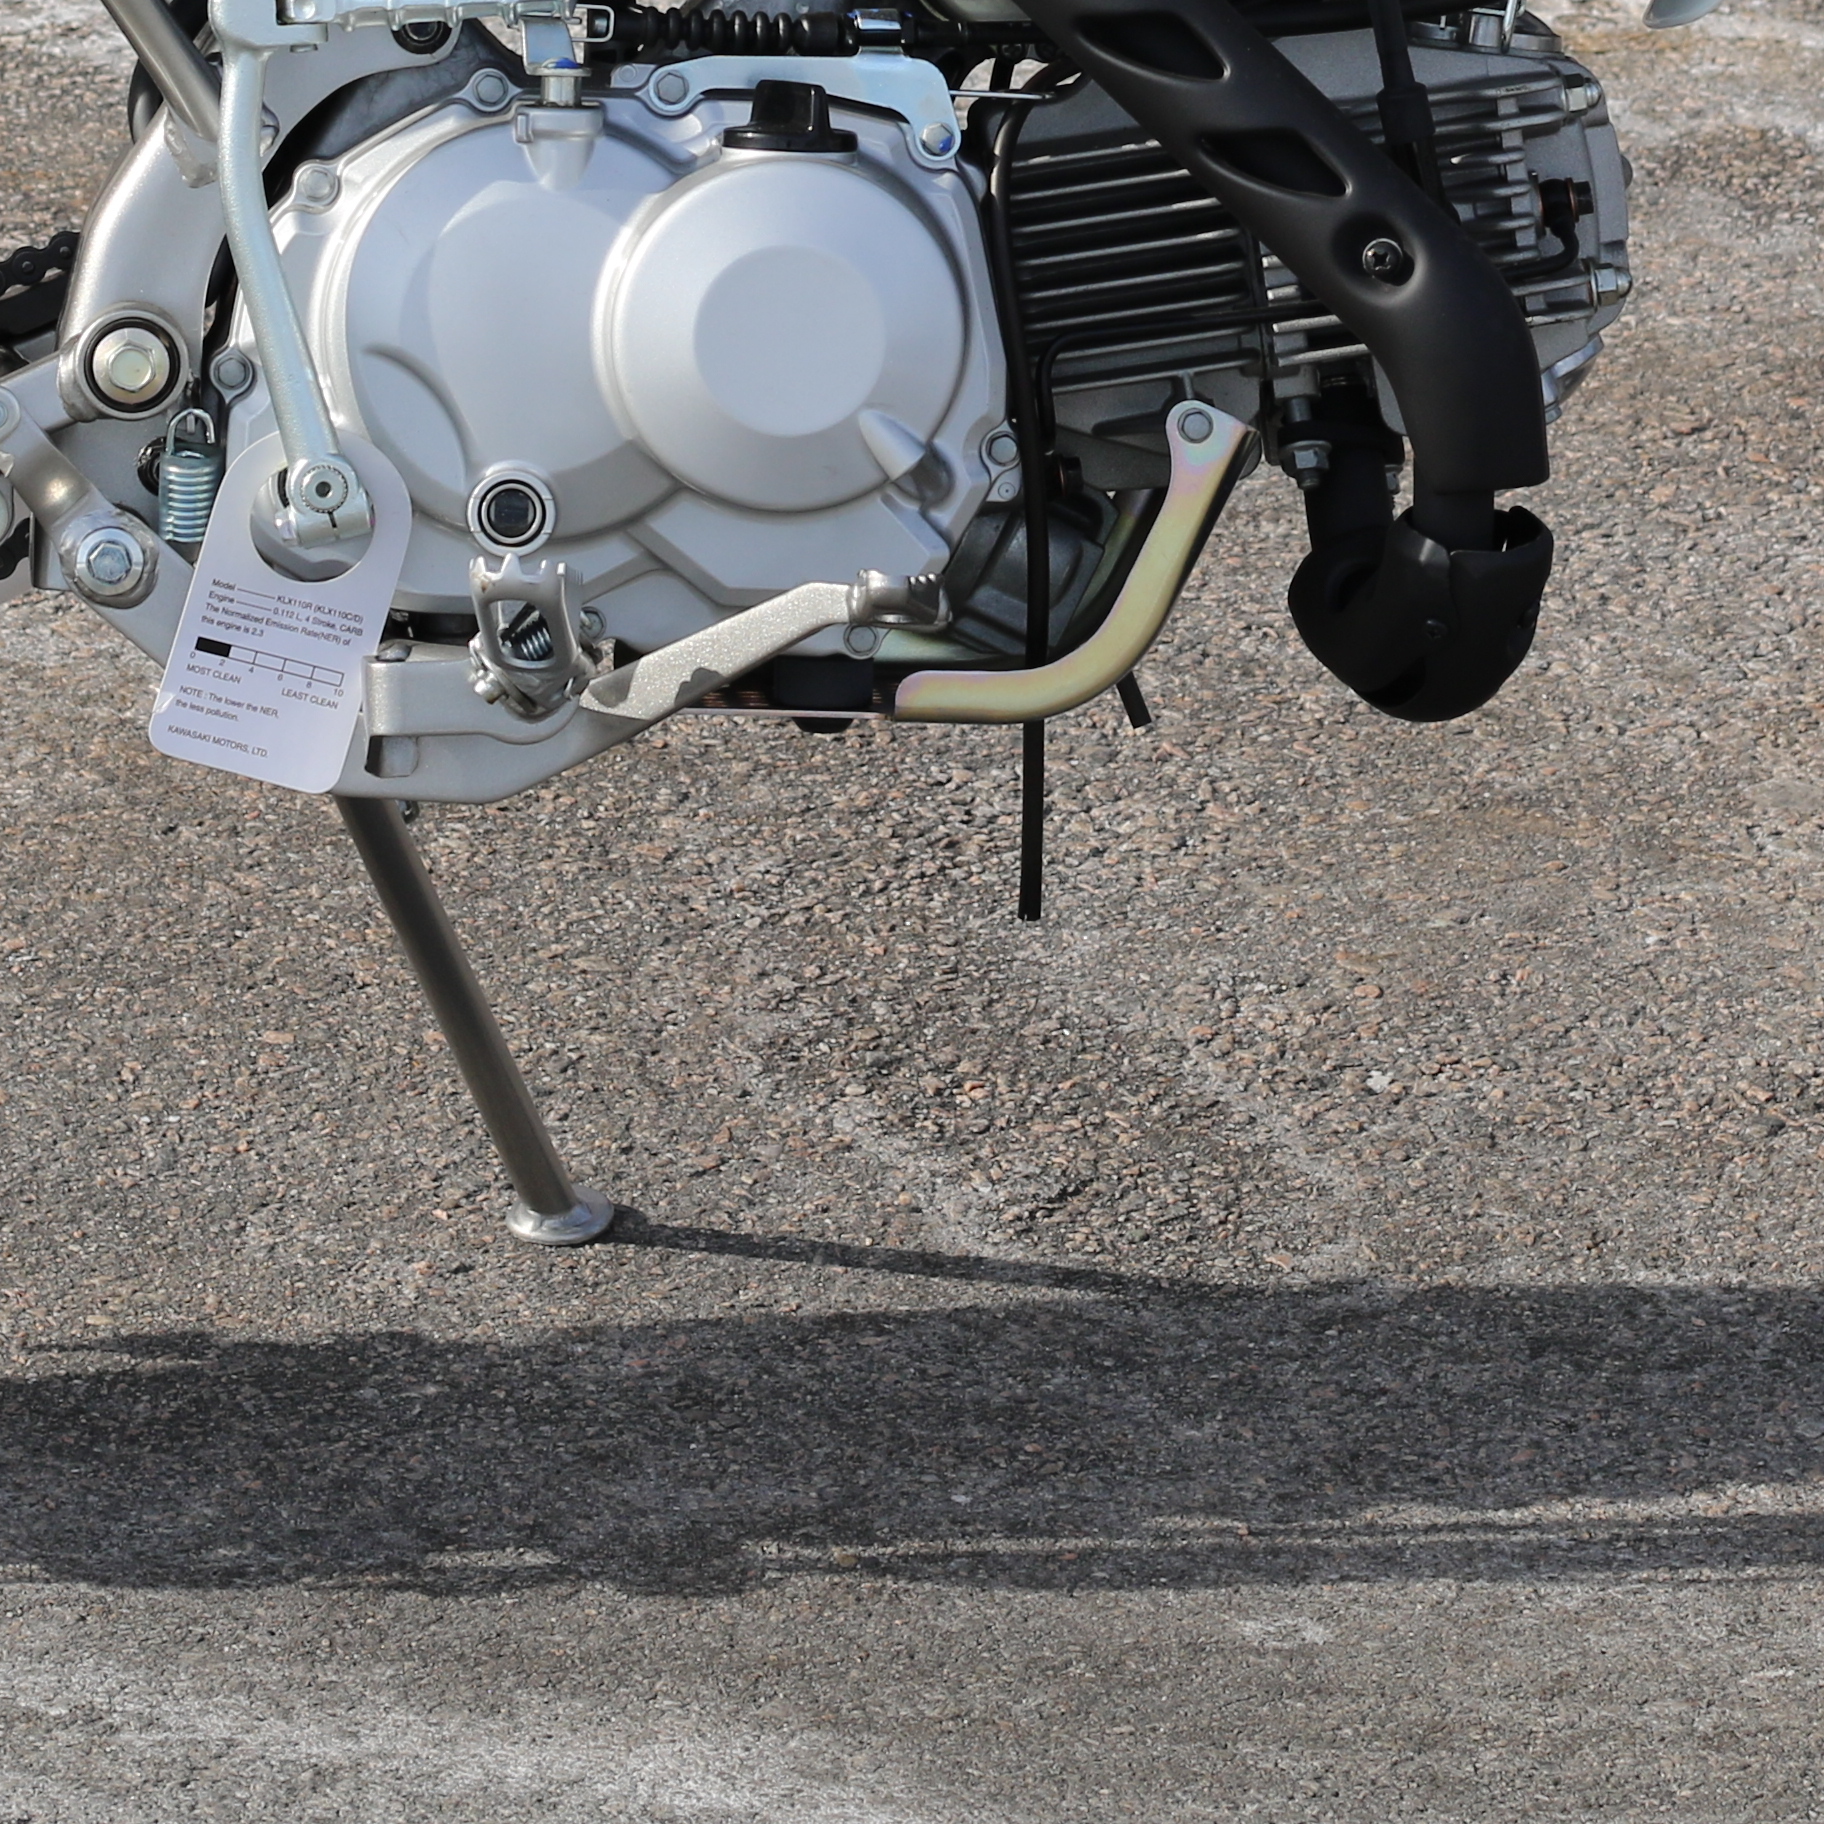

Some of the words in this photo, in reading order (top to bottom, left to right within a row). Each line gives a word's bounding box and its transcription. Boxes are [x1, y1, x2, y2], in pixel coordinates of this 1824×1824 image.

[208, 591, 235, 604] Engine
[272, 607, 294, 619] 0.112
[339, 623, 364, 637] CARB
[212, 578, 236, 591] Model
[276, 595, 313, 611] KLX110R
[314, 605, 364, 624] (KLX110C/D)
[201, 615, 215, 626] this
[216, 620, 242, 633] engine
[243, 624, 250, 633] is
[251, 626, 265, 637] 2.3
[205, 602, 219, 613] The
[221, 606, 264, 625] Normalized
[265, 618, 300, 634] Emission
[342, 638, 351, 646] of
[186, 663, 211, 676] MOST
[212, 670, 242, 684] CLEAN
[189, 651, 196, 659] 0
[248, 666, 255, 674] 4
[306, 681, 313, 689] 8
[333, 687, 344, 698] 10
[176, 698, 188, 708] the
[189, 702, 205, 713] less
[205, 707, 239, 722] pollution.
[209, 692, 223, 703] The
[224, 696, 245, 709] lower
[246, 702, 259, 712] the
[281, 687, 308, 702] LEAST
[309, 695, 339, 710] CLEAN
[167, 725, 211, 743] KAWASAKI
[251, 746, 269, 758] LTD.
